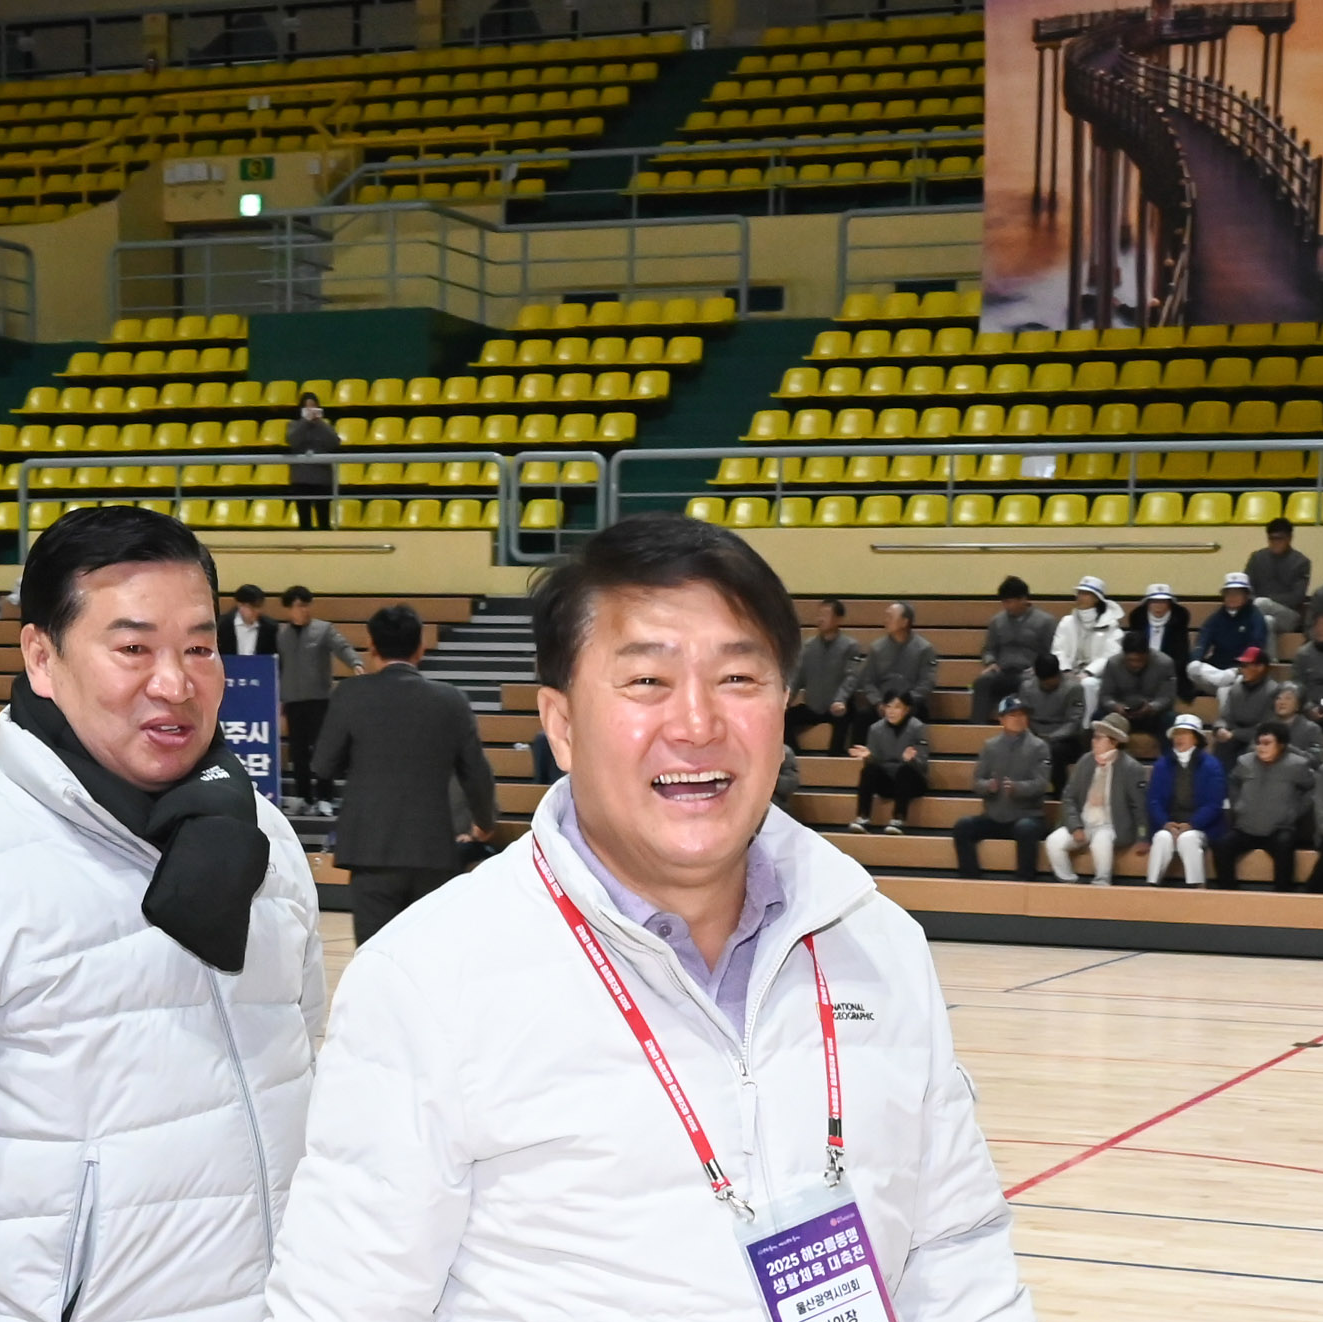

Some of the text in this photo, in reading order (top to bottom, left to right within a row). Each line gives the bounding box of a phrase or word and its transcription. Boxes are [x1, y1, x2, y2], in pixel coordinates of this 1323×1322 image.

[219, 721, 269, 744] 주시
[766, 1252, 800, 1277] 2025
[800, 1226, 860, 1263] 해오름동맹
[772, 1261, 826, 1295] 생활체육
[827, 1244, 866, 1272] 대축전
[795, 1278, 861, 1316] 울산광역시의회
